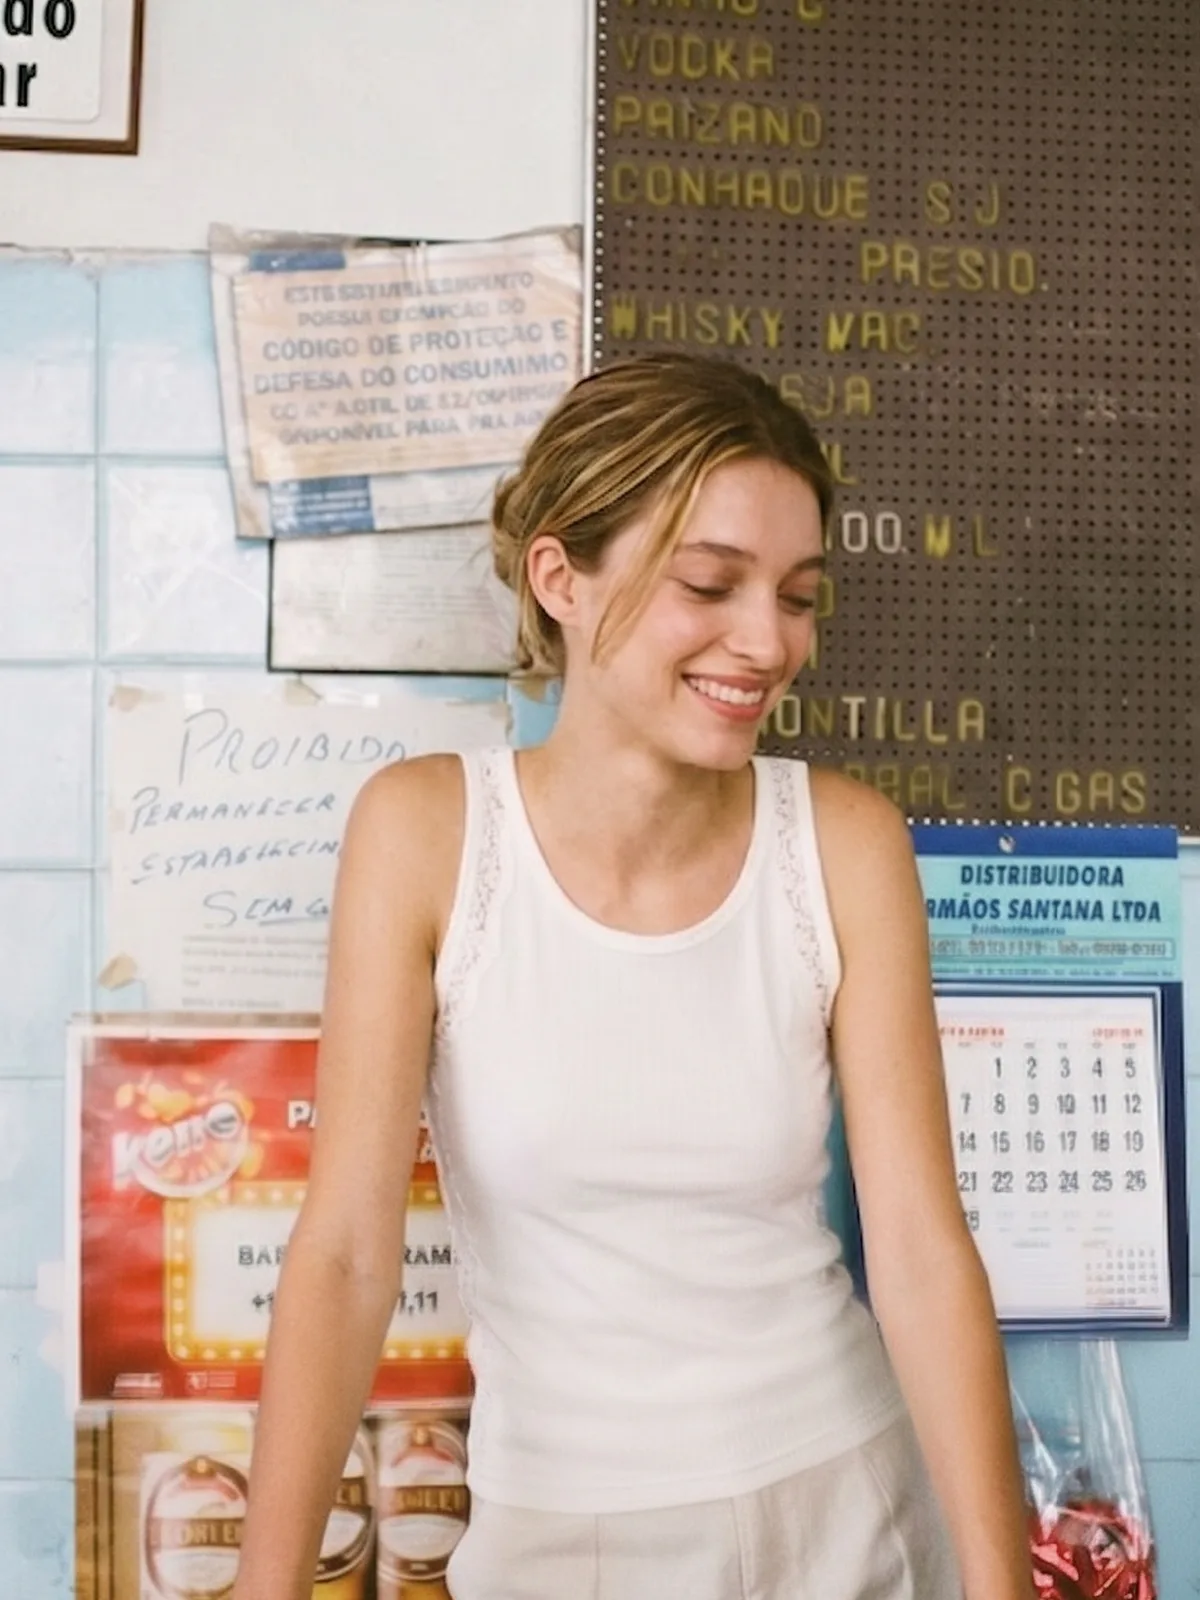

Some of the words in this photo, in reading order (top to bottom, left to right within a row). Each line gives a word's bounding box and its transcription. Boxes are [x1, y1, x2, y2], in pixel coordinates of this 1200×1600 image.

[617, 33, 774, 81] VODKA
[760, 696, 985, 742] ONTILLA
[1056, 770, 1147, 814] GAS
[960, 864, 1125, 888] DISTRIBUIDORA
[1007, 898, 1104, 922] SANTANA
[1112, 900, 1161, 923] LTDA
[994, 1056, 1002, 1079] 1
[1027, 1056, 1037, 1079] 2
[1061, 1057, 1070, 1078] 3
[1092, 1057, 1103, 1078] 4
[1125, 1057, 1136, 1079] 5
[960, 1093, 971, 1115] 7
[994, 1093, 1005, 1114] 8
[1028, 1093, 1039, 1115] 9
[1057, 1093, 1075, 1114] 10
[1092, 1094, 1106, 1114] 11
[1124, 1093, 1141, 1114] 12
[958, 1131, 976, 1153] 14
[992, 1131, 1010, 1153] 15
[1026, 1130, 1045, 1153] 16
[1060, 1131, 1077, 1152] 17
[1091, 1131, 1109, 1152] 18
[1124, 1130, 1144, 1153] 19
[958, 1171, 977, 1193] 21
[992, 1171, 1013, 1193] 22
[1026, 1171, 1048, 1192] 23
[1059, 1170, 1079, 1193] 24
[1091, 1170, 1113, 1192] 25
[1125, 1170, 1147, 1191] 26
[964, 1209, 980, 1231] 8
